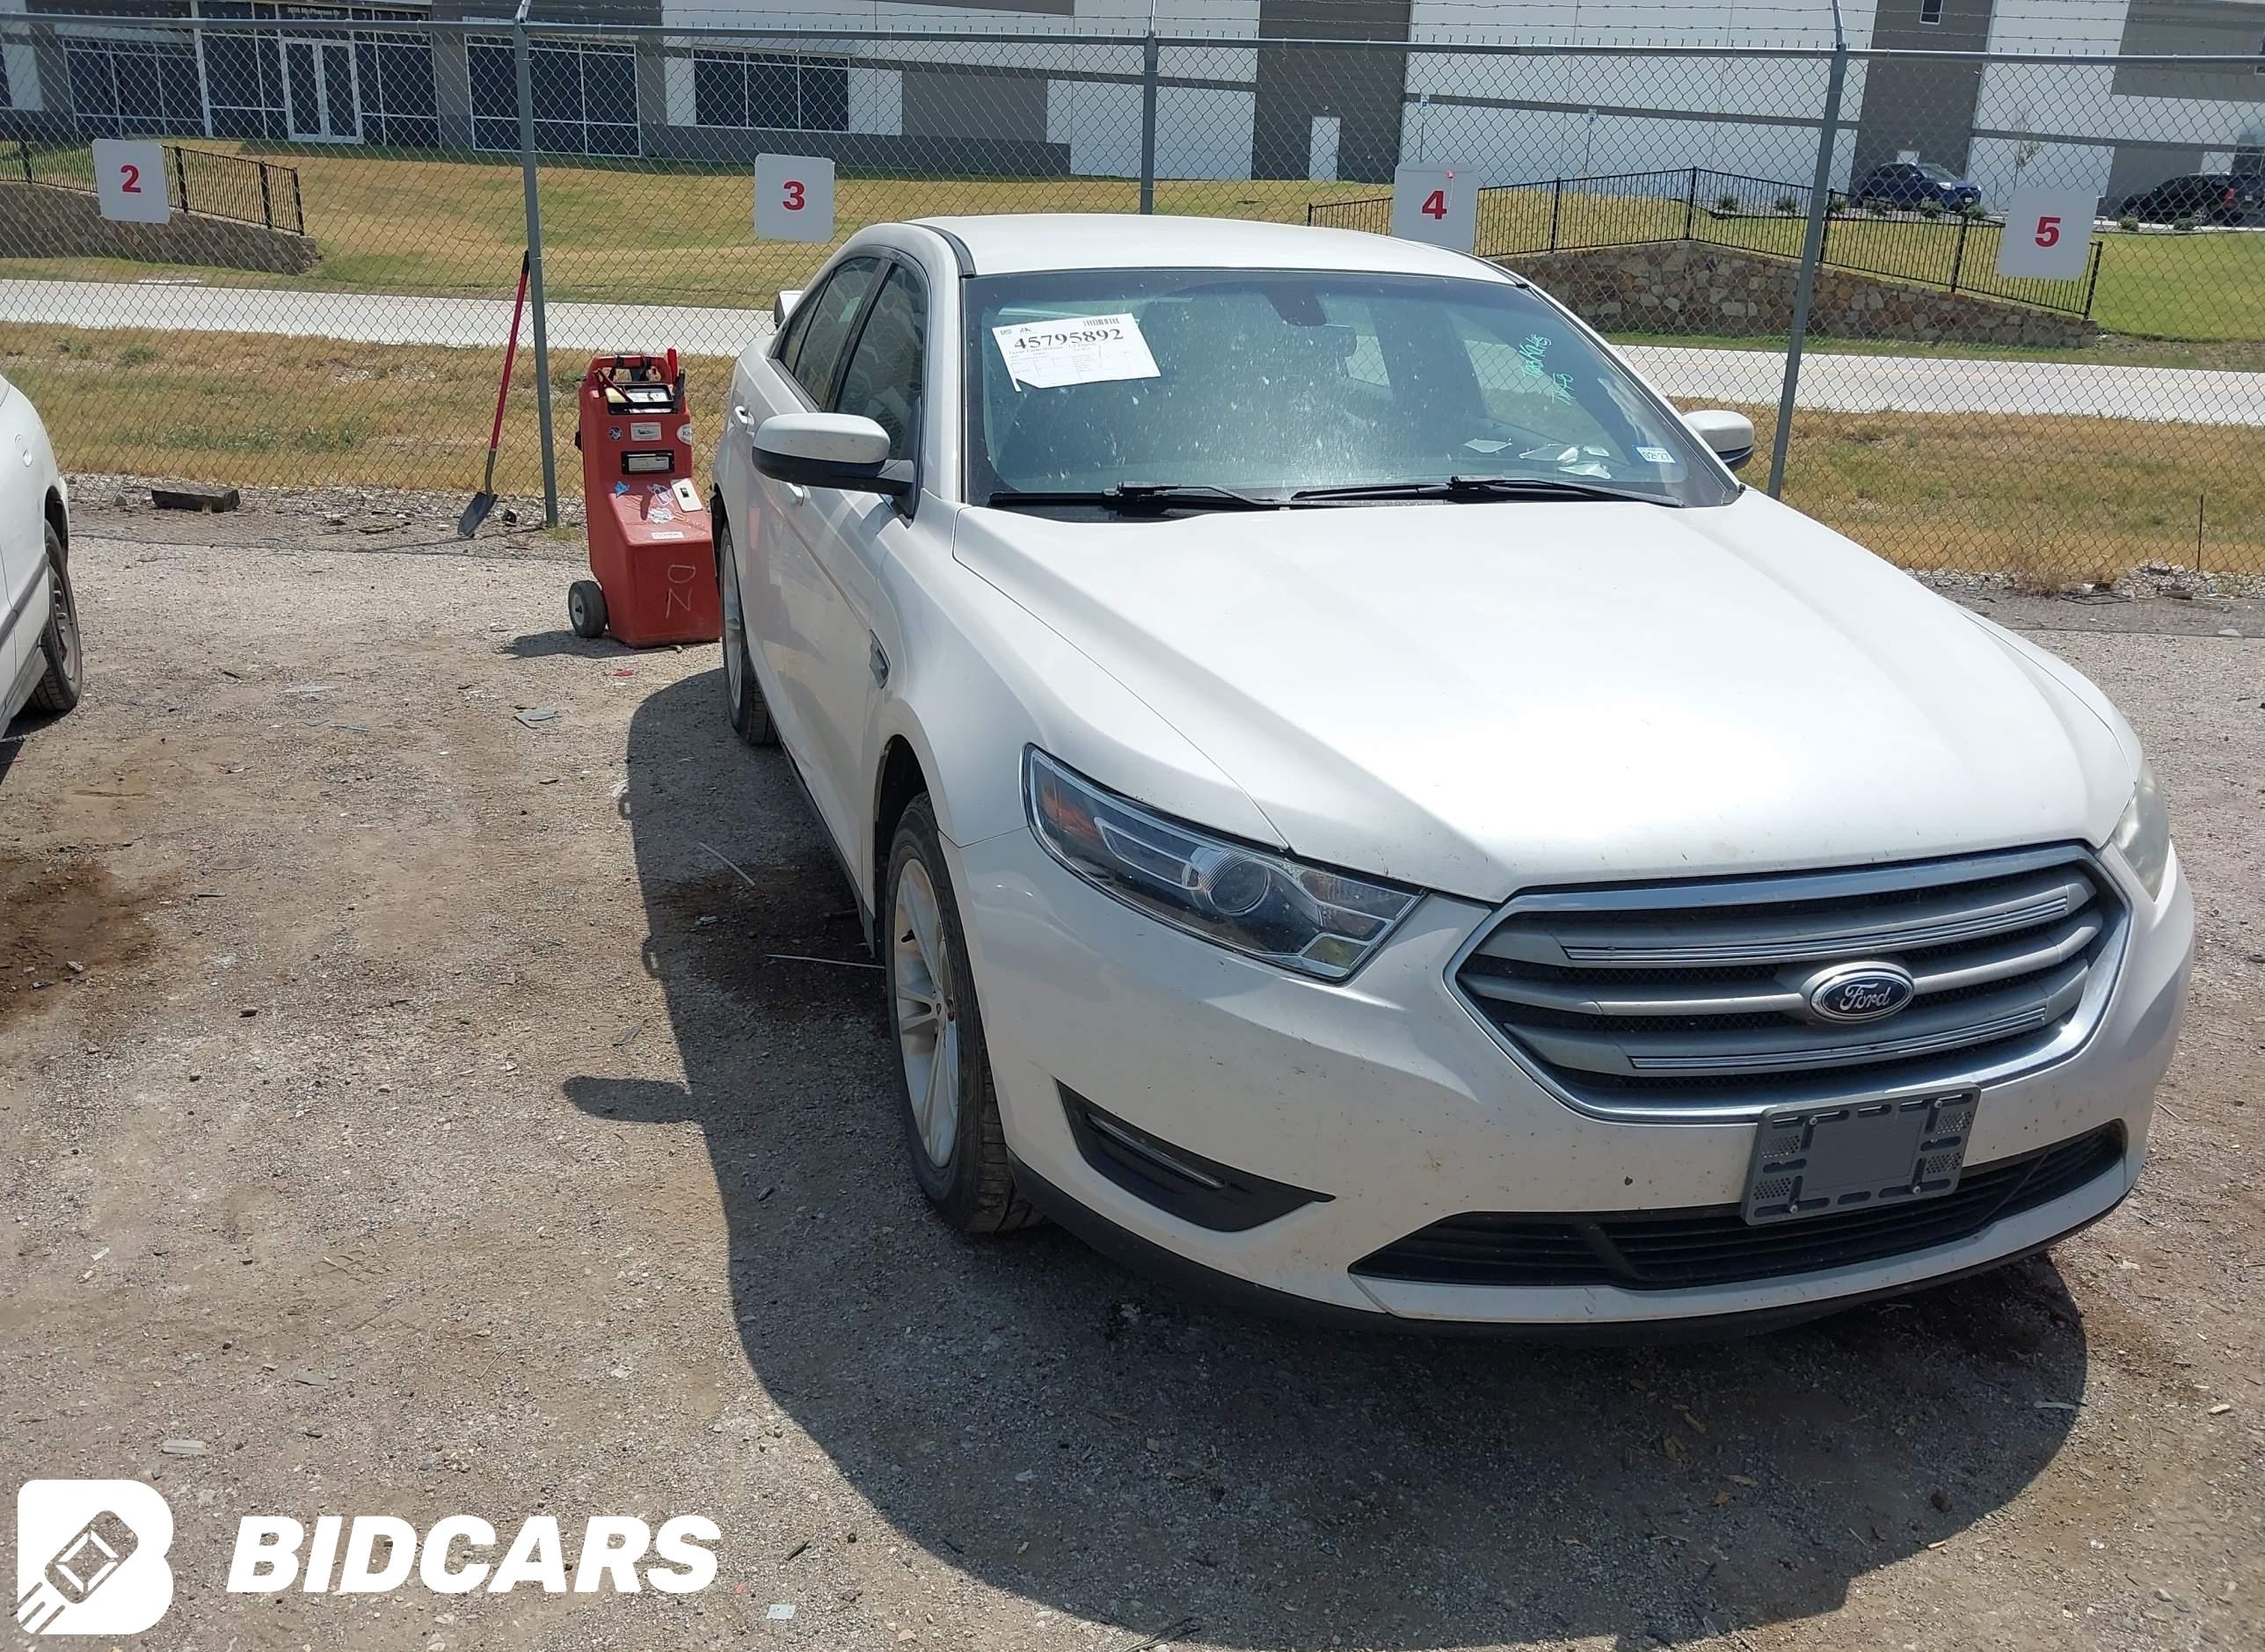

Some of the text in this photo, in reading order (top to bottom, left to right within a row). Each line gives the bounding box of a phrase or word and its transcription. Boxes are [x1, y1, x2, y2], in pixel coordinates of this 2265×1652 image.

[120, 164, 142, 193] 2
[783, 180, 806, 211] 3
[1421, 190, 1448, 220] 4
[2035, 216, 2062, 248] 5
[1014, 328, 1125, 349] 45795892
[1839, 982, 1891, 1011] Ford
